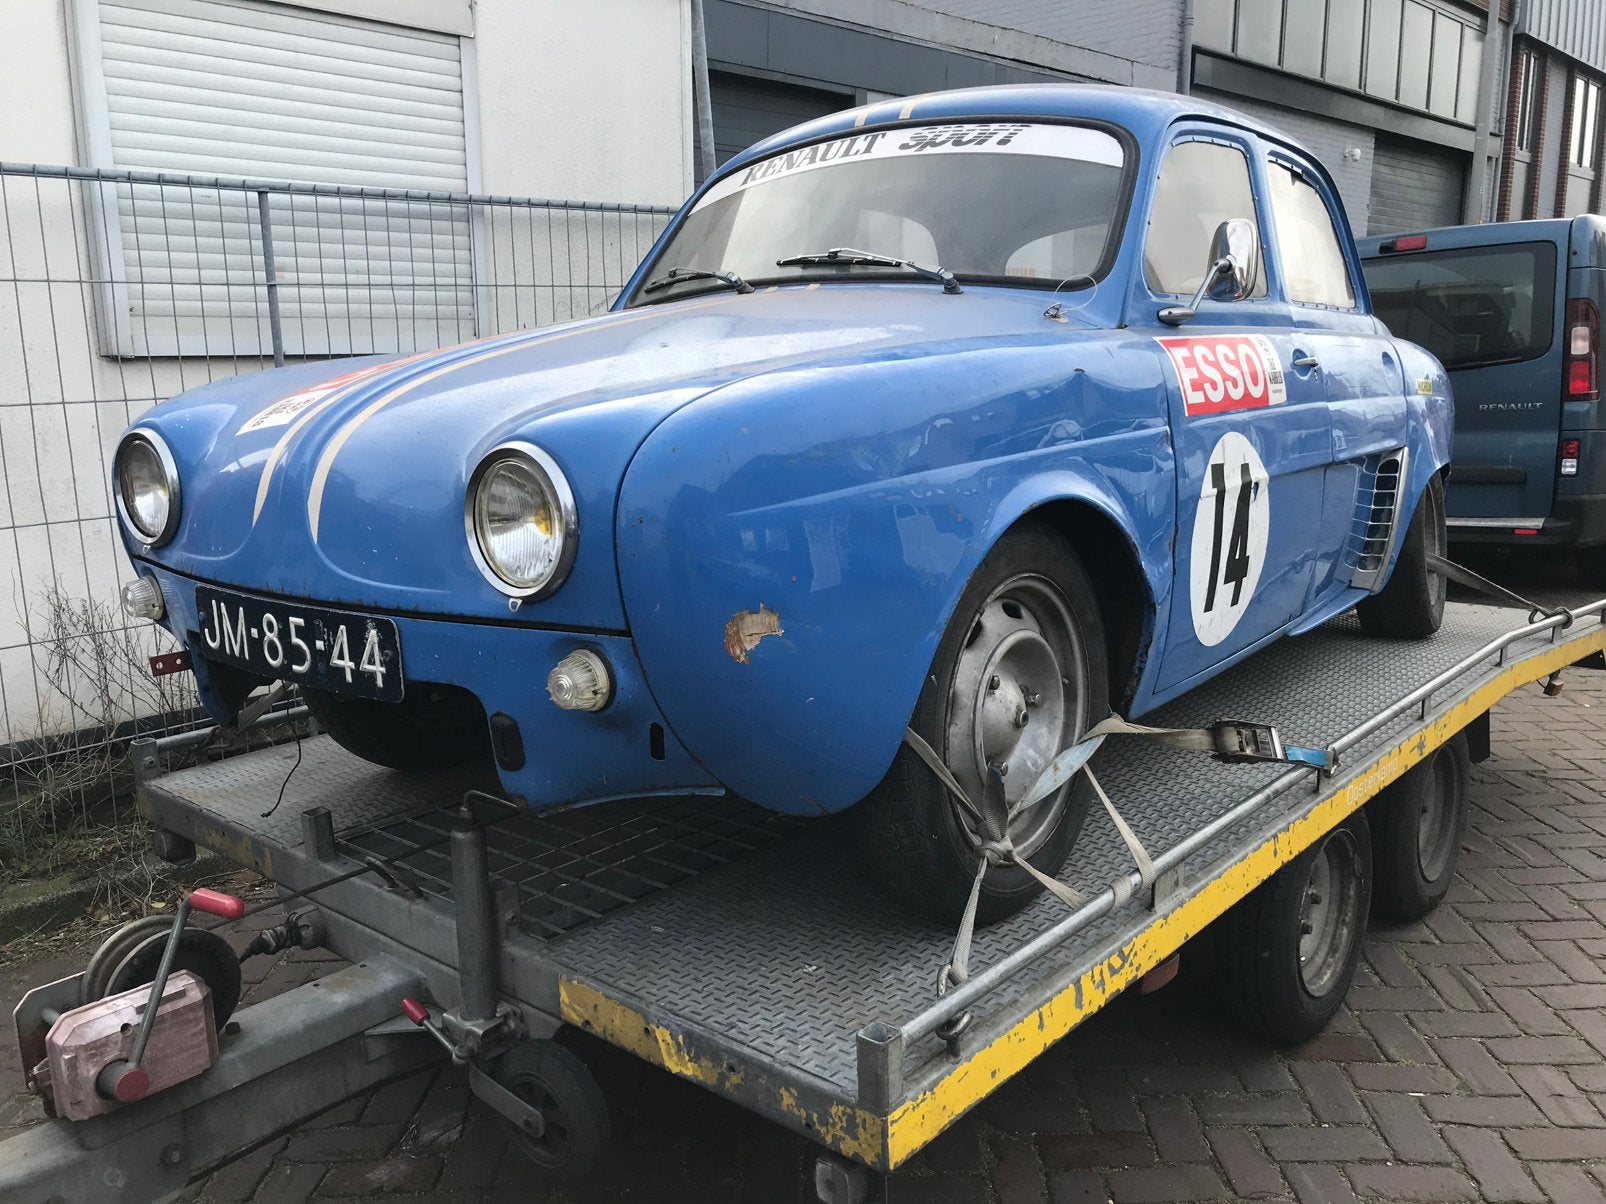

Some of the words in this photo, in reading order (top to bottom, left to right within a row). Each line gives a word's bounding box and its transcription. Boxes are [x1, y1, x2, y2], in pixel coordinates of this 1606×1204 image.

[739, 132, 888, 187] RENAULT
[1169, 343, 1265, 404] ESSO
[1479, 402, 1544, 412] RENAULT
[1204, 463, 1253, 613] 14
[204, 599, 386, 689] JM-85-44
[1346, 757, 1398, 805] Oosterkamp
